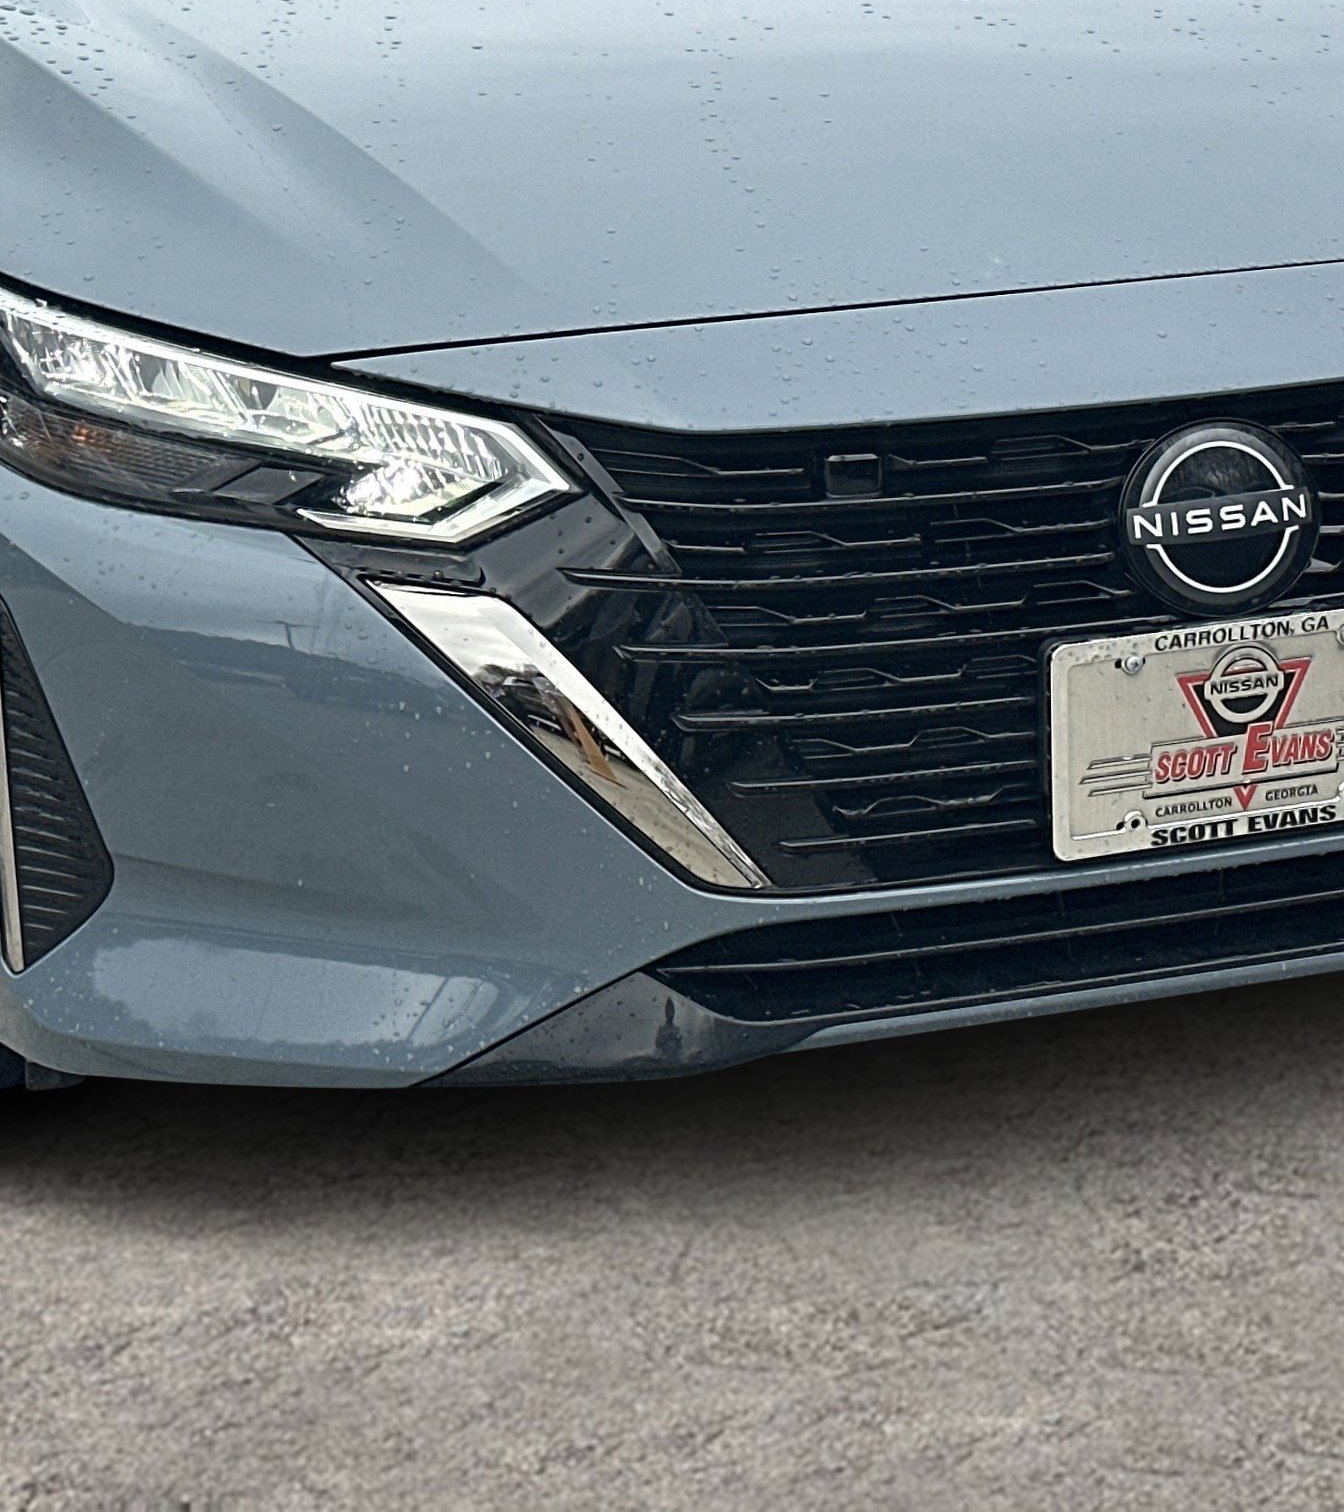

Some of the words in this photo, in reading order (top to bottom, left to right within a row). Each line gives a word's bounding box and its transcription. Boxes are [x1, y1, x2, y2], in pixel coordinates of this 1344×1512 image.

[1132, 493, 1307, 540] NISSAN
[1154, 620, 1295, 651] CARROLLTON,
[1302, 616, 1329, 632] GA
[1210, 675, 1279, 695] NISSAN
[1155, 742, 1237, 784] SCOTT
[1241, 721, 1335, 775] EVANS
[1156, 796, 1232, 817] CARROLLTON
[1265, 784, 1319, 802] GEORGIA
[1150, 818, 1238, 846] SCOTT
[1248, 804, 1337, 833] EVANS
